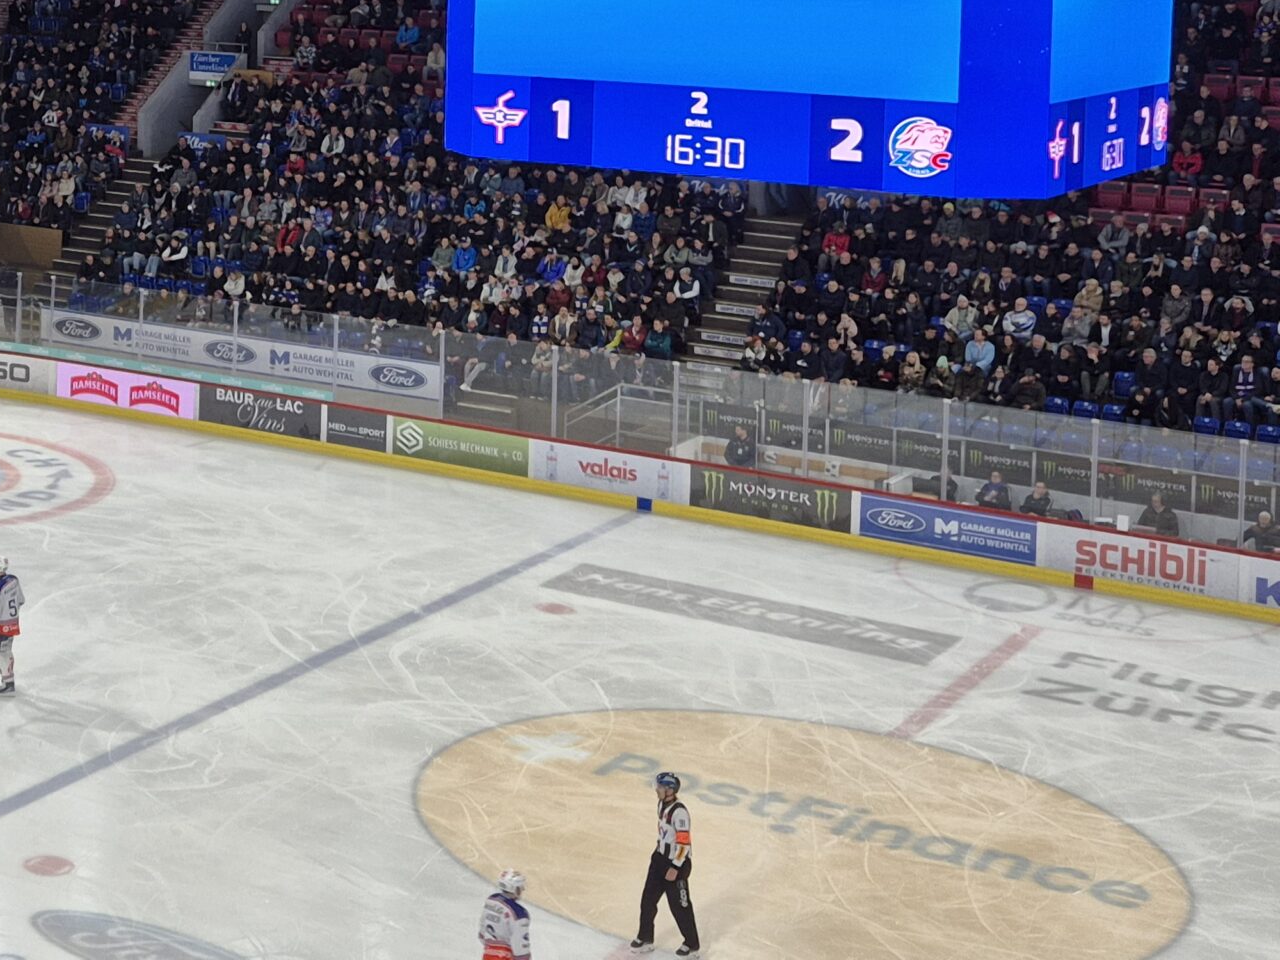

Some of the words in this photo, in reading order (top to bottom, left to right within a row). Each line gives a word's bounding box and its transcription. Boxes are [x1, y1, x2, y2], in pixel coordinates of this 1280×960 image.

[690, 91, 709, 115] 2
[1109, 96, 1117, 120] 2
[552, 99, 570, 140] 1
[1140, 106, 1150, 146] 2
[666, 134, 745, 169] 16:30
[830, 118, 863, 163] 2
[1072, 121, 1080, 164] 1
[889, 148, 952, 171] ZSC
[61, 320, 92, 338] Ford
[292, 352, 323, 364] GARAGE
[292, 365, 314, 376] AUTO
[379, 366, 415, 386] Ford
[72, 380, 116, 397] RAMSEIER
[131, 390, 177, 408] RAMSEIER
[216, 388, 253, 405] BAUR
[276, 397, 304, 414] LAC
[237, 398, 286, 433] Vins
[358, 426, 385, 439] SPORT
[428, 437, 458, 450] SCHIESS
[460, 442, 499, 458] MECHANIK
[578, 458, 638, 482] valais
[729, 480, 812, 507] MONSTER
[877, 510, 914, 530] Ford
[961, 522, 996, 536] GARAGE
[997, 528, 1032, 540] MÜLLER
[960, 536, 985, 546] AUTO
[987, 540, 1031, 553] WEHNTAL
